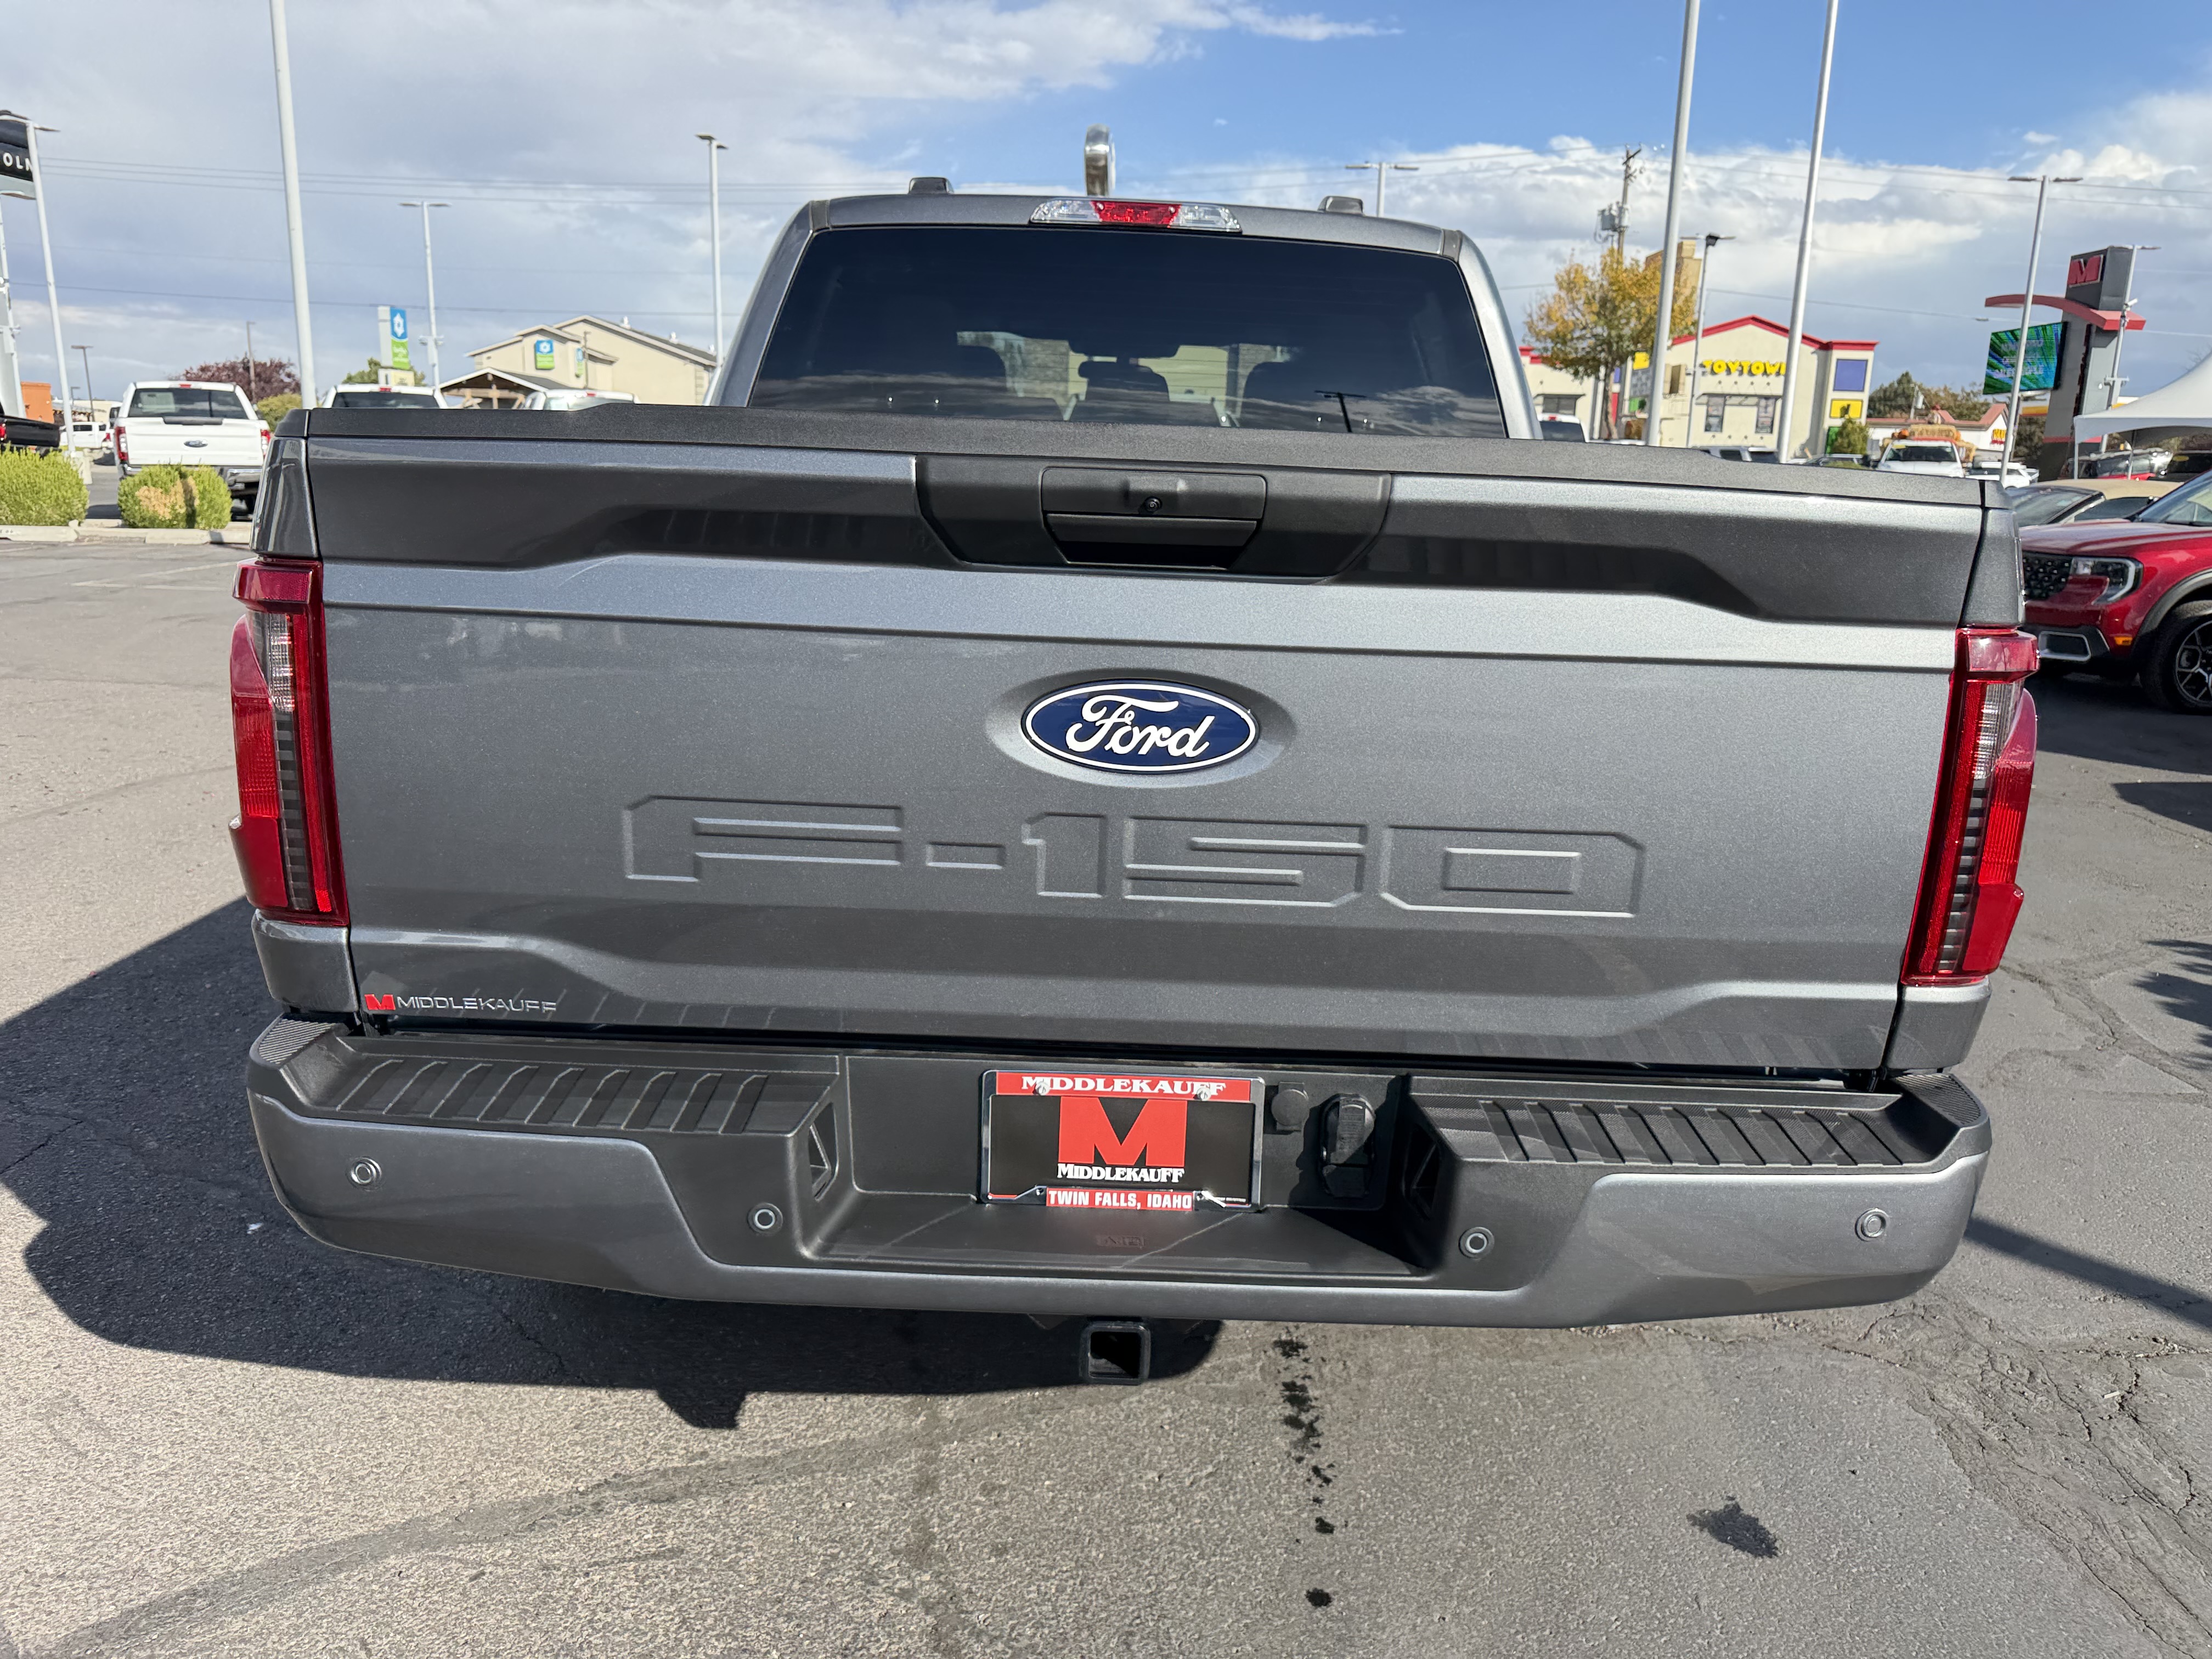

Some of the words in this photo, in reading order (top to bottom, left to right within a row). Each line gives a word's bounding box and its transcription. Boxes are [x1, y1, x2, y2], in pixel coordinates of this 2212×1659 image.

[2067, 254, 2103, 287] M
[1065, 695, 1215, 758] Ford
[622, 795, 1645, 918] F-150
[364, 994, 396, 1010] M
[397, 996, 557, 1013] MIDDLEKAUFF
[1021, 1075, 1227, 1096] MIDDLEKAUFF
[1058, 1096, 1188, 1167] M
[1057, 1163, 1185, 1183] MIDDLEKAUFF
[1048, 1190, 1090, 1206] TWIN
[1094, 1192, 1141, 1210] FALLS,
[1147, 1194, 1192, 1209] IDAHO
